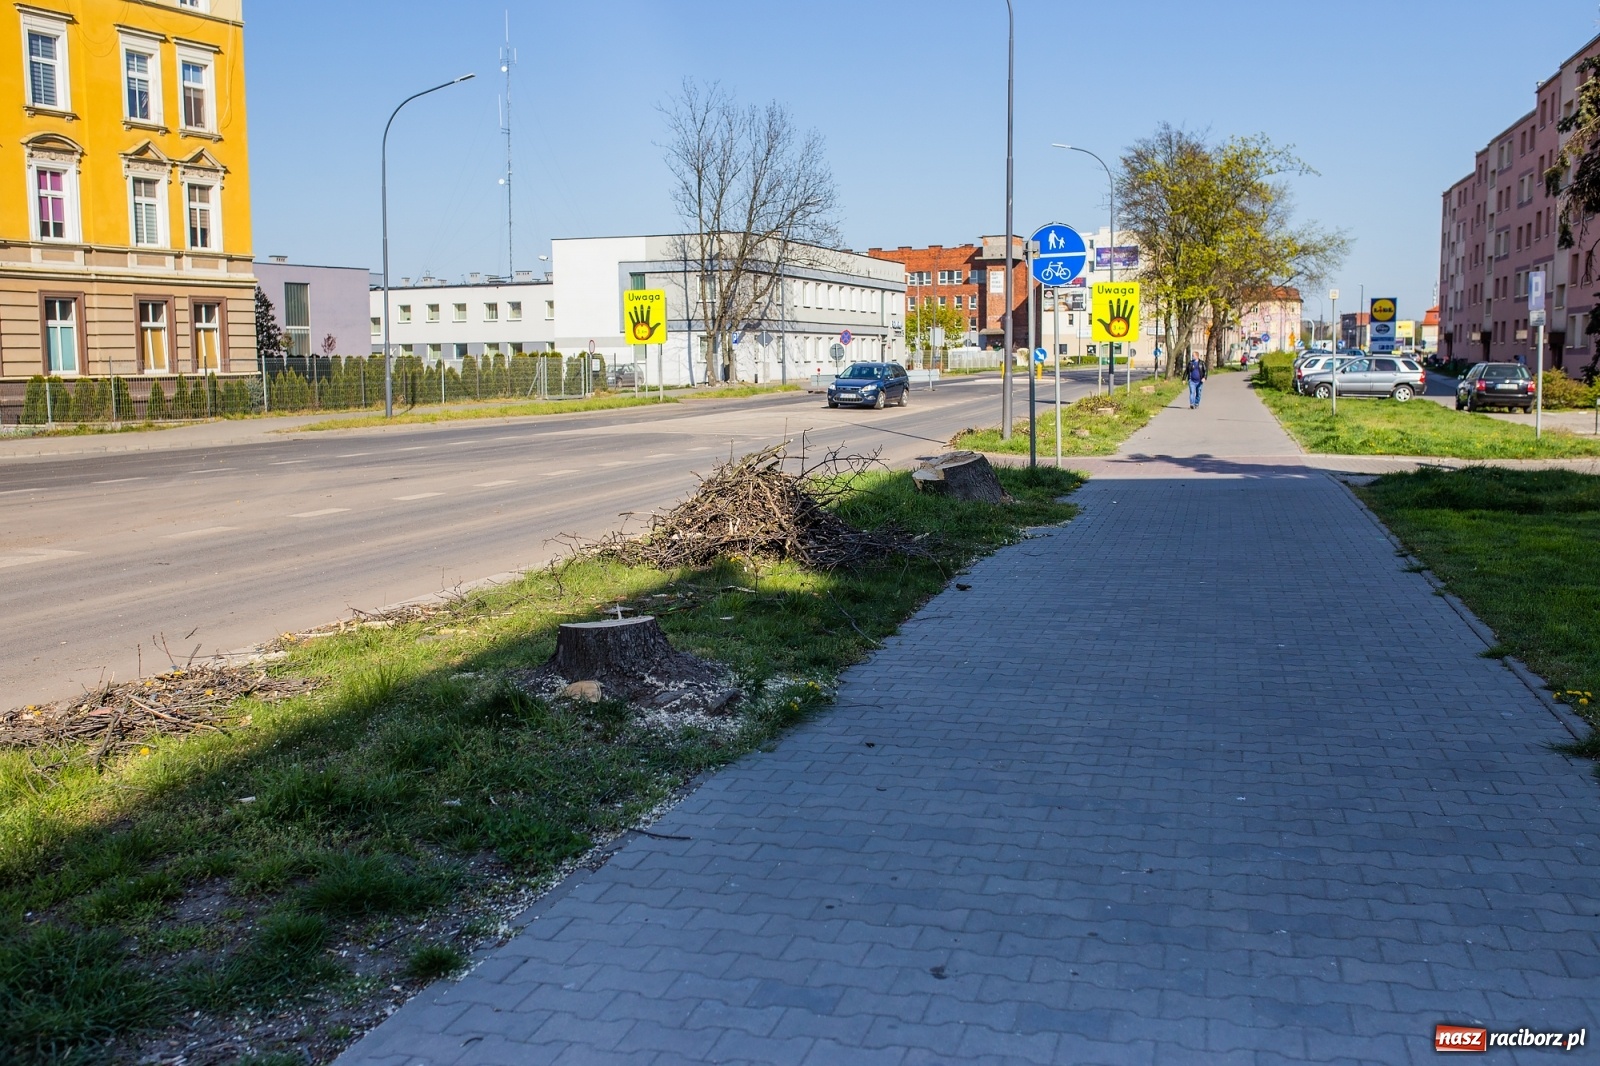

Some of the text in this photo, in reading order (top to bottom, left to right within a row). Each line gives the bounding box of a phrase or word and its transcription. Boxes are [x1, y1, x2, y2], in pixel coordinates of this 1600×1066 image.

[1097, 285, 1135, 296] Uwaga
[1532, 276, 1542, 306] P
[628, 293, 661, 303] Uwaga
